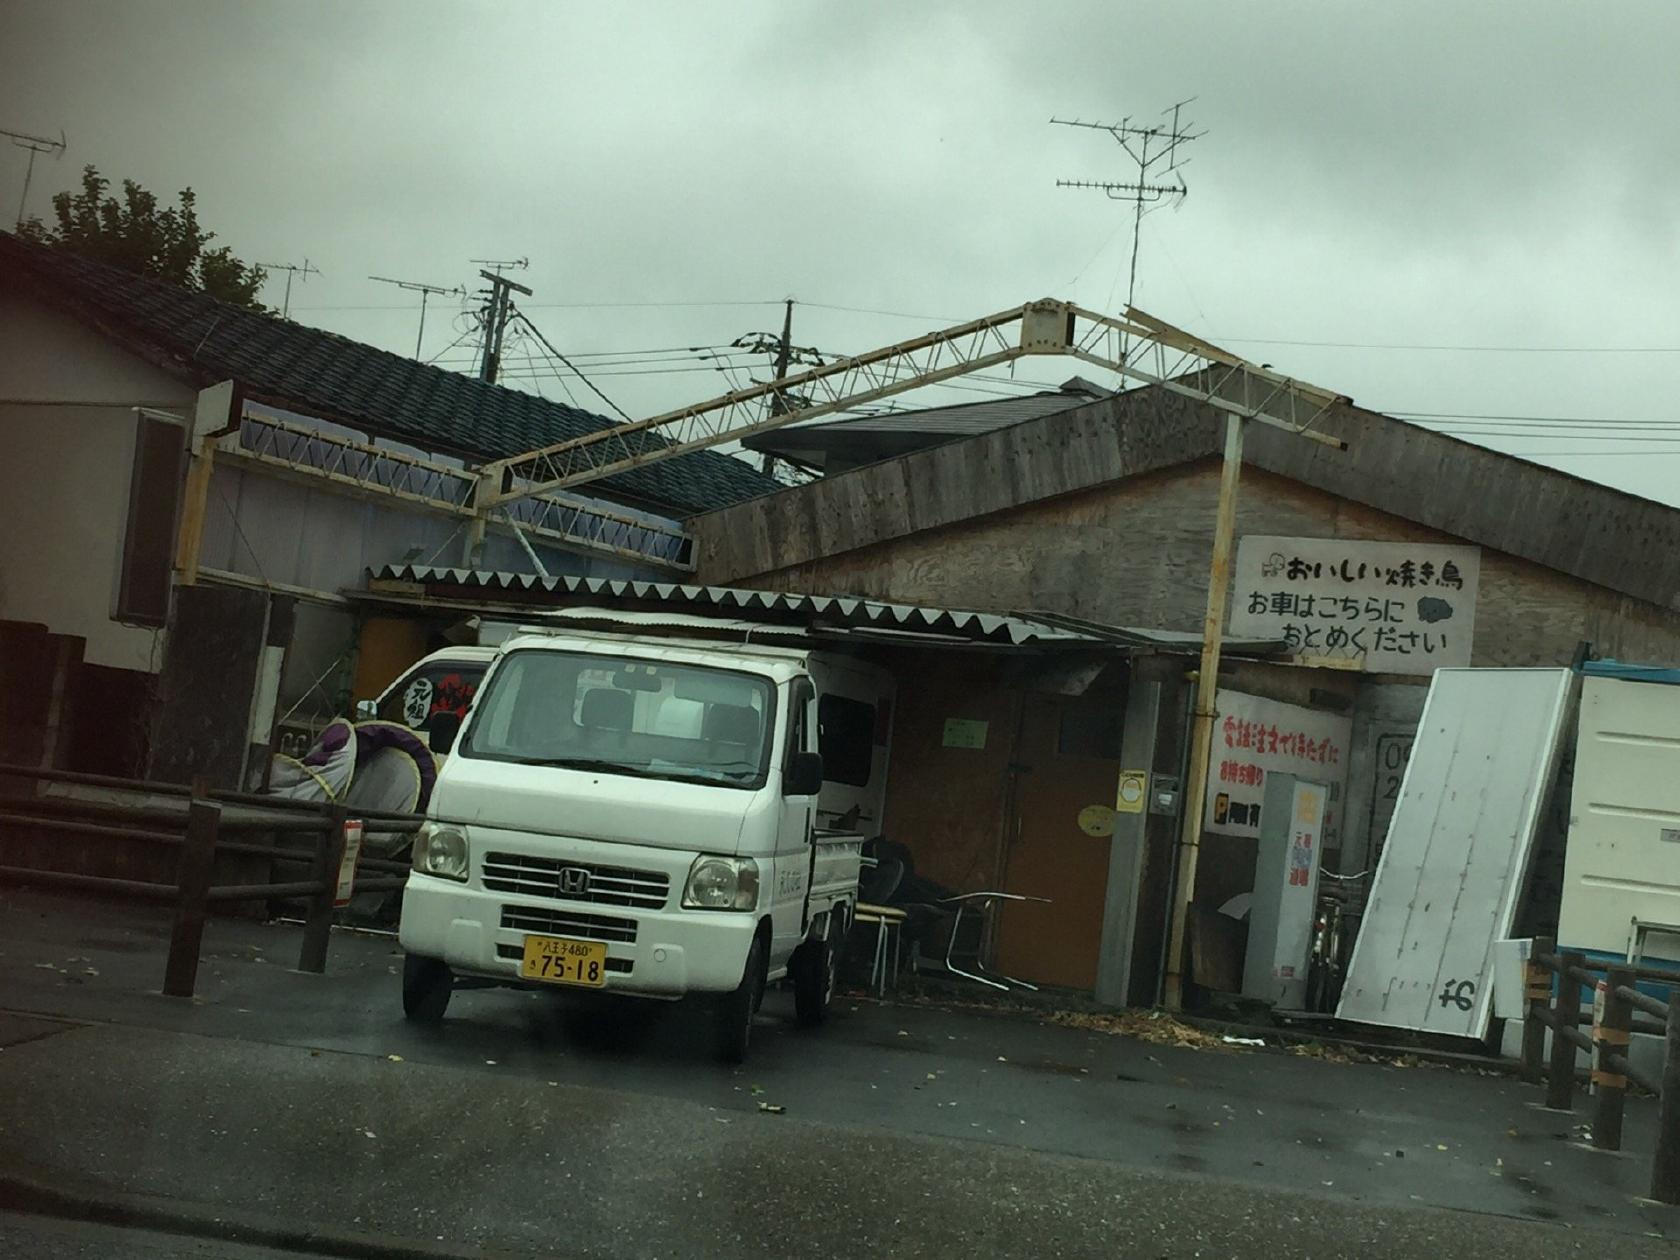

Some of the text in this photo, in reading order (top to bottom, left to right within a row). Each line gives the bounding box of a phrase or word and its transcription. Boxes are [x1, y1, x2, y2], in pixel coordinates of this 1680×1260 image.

[1287, 556, 1464, 591] おいしい焼き鳥
[1247, 590, 1406, 624] お車はこちらに
[1282, 623, 1447, 655] おとめください
[541, 955, 599, 982] 75-18
